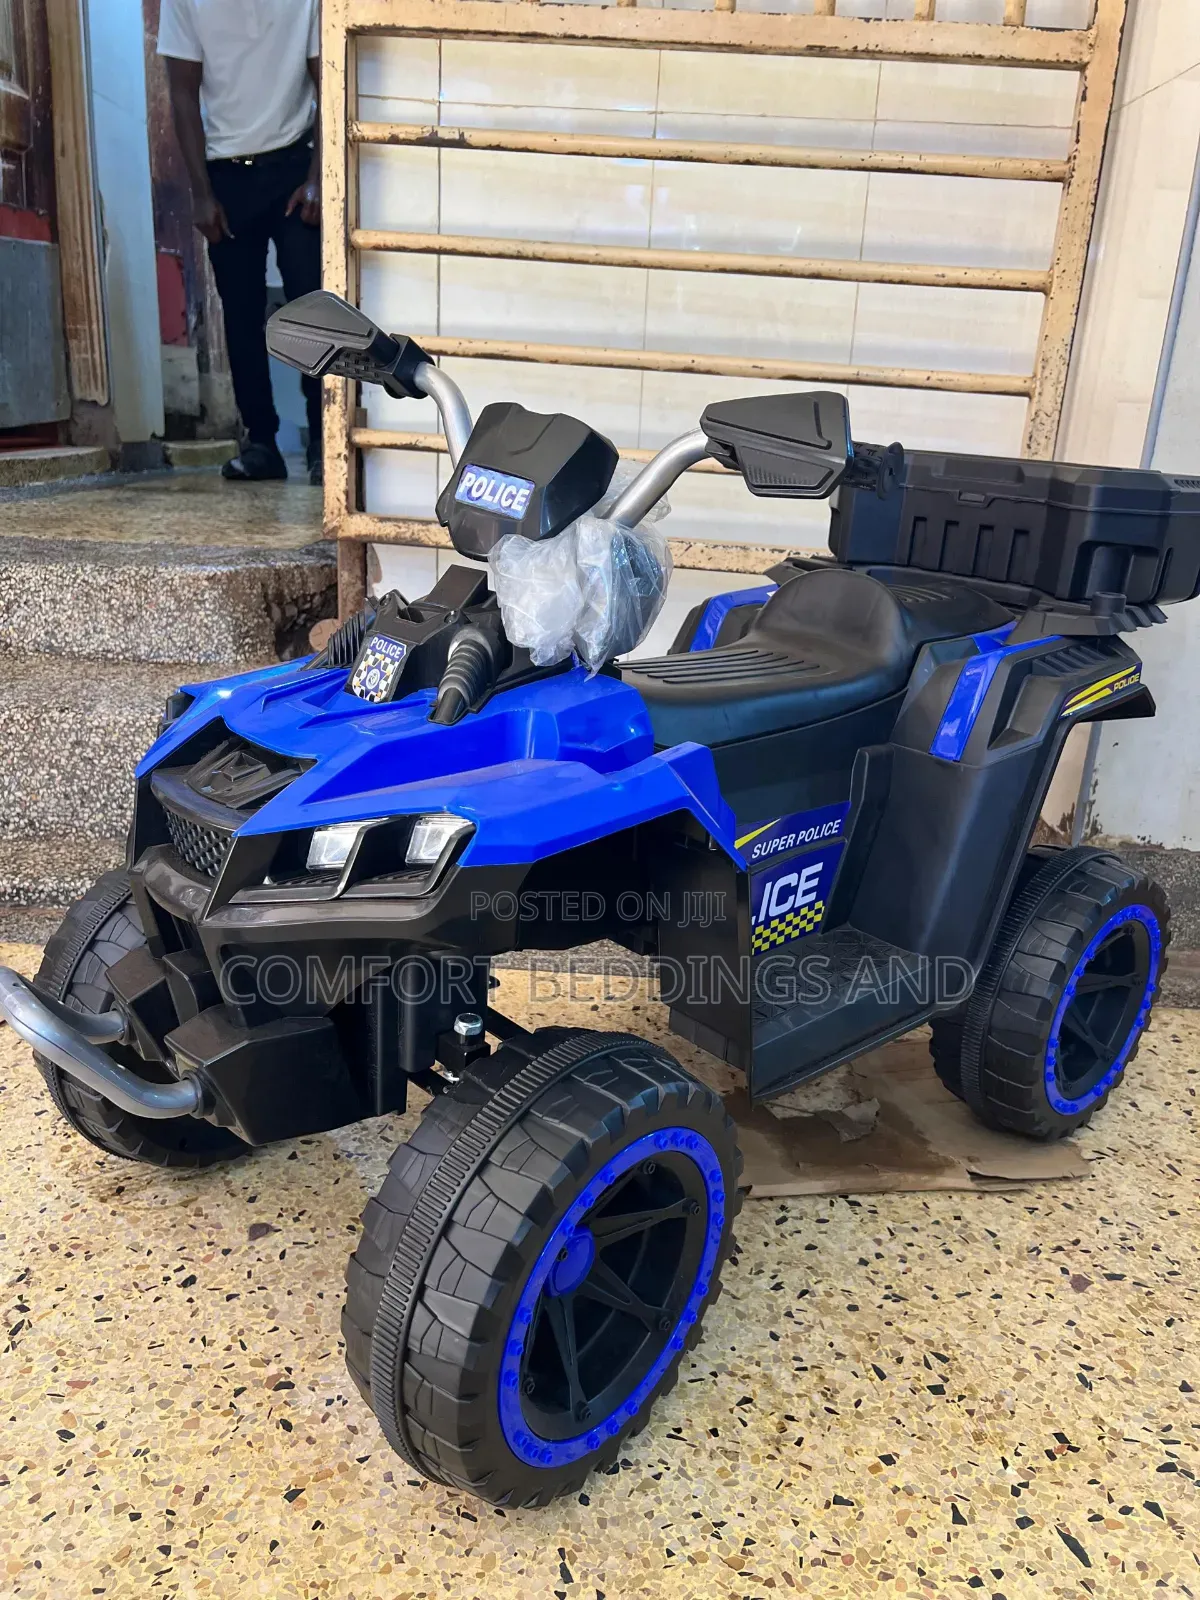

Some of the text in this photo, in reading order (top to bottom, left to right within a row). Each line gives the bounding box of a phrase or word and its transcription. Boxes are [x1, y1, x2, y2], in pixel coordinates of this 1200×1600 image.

[458, 472, 530, 511] POLICE
[370, 636, 403, 659] POLICE
[752, 818, 842, 859] SUPER POLICE
